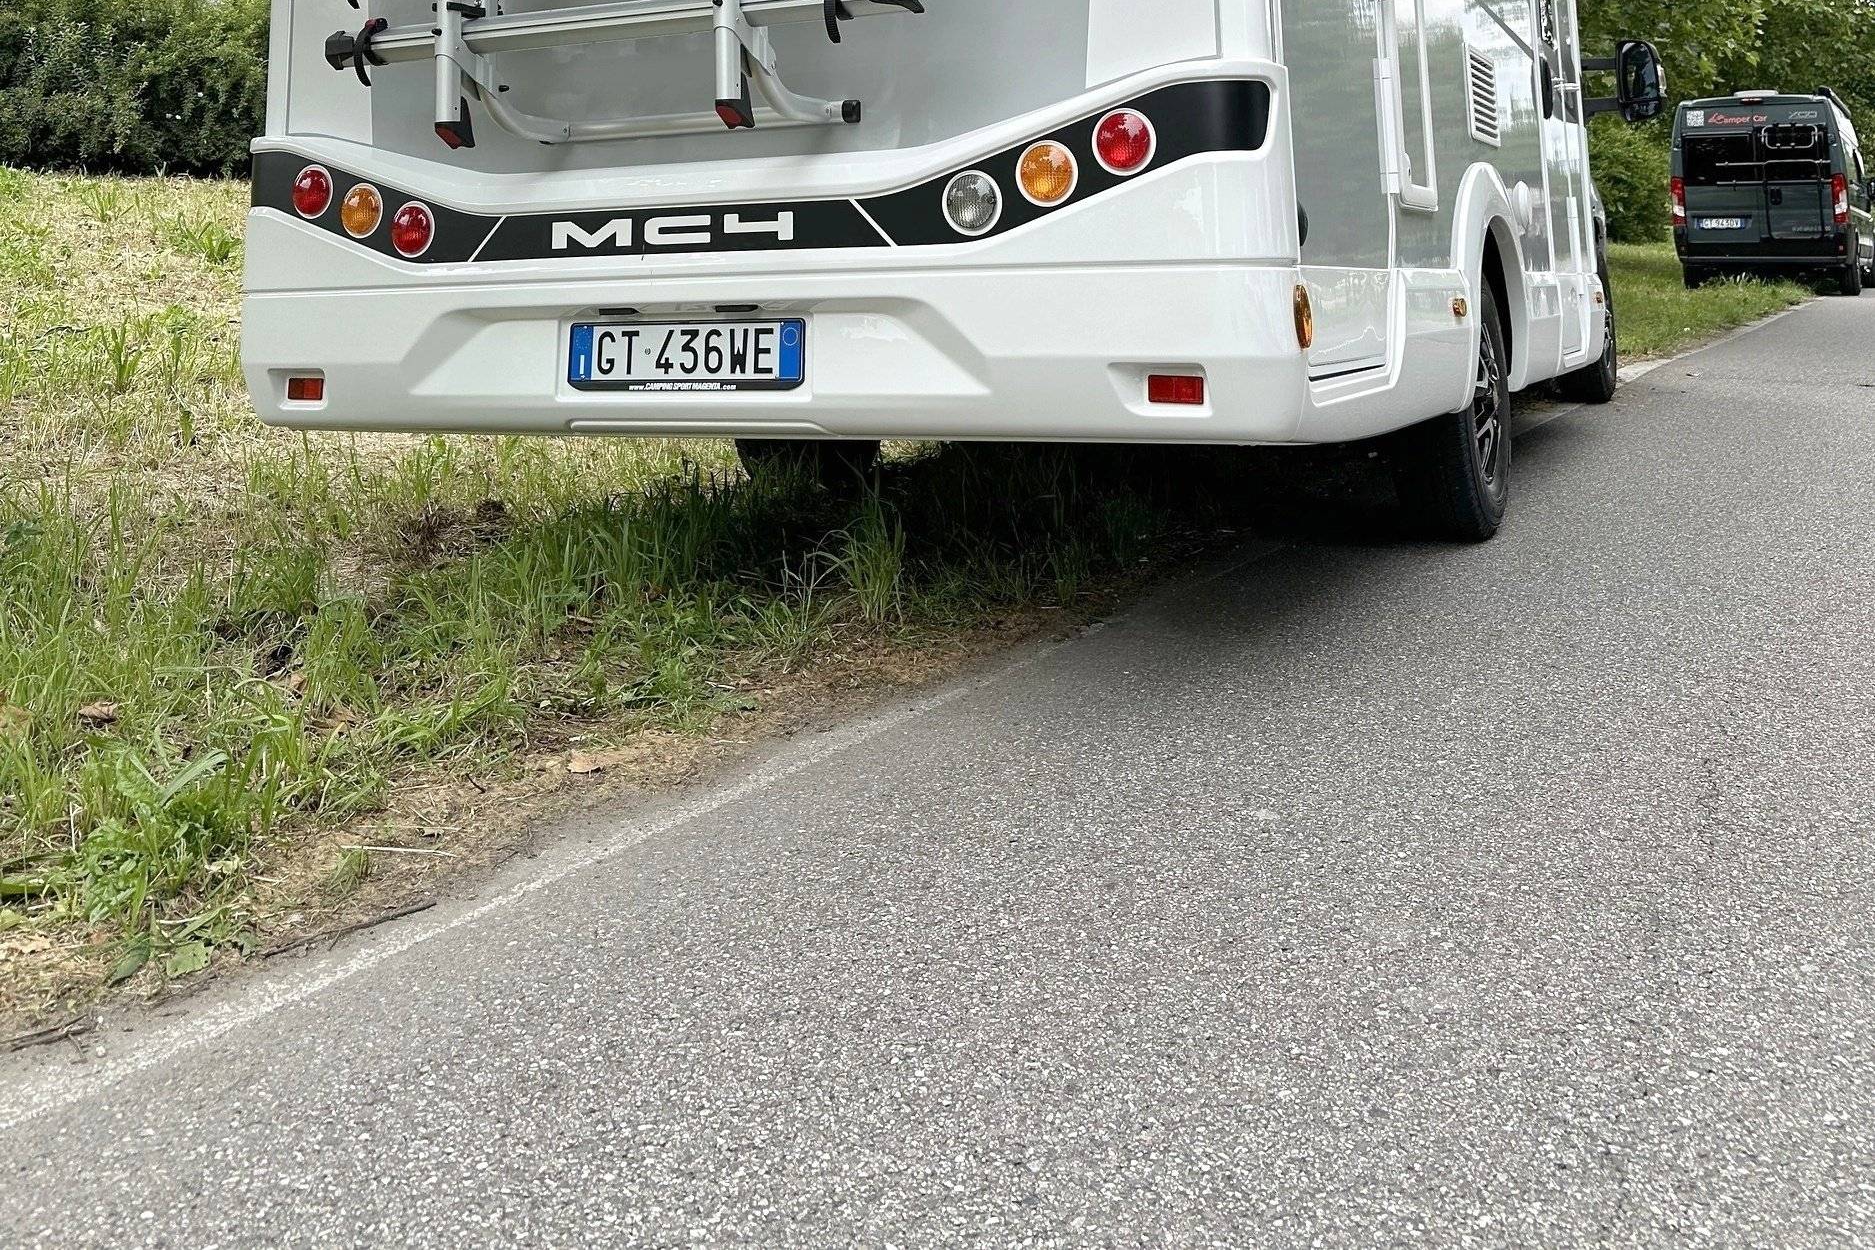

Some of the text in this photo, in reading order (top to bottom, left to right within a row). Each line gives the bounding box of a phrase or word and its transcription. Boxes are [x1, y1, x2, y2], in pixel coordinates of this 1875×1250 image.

[1708, 113, 1767, 124] Camper Car
[551, 210, 794, 250] MC4
[596, 326, 775, 376] GT 436WE
